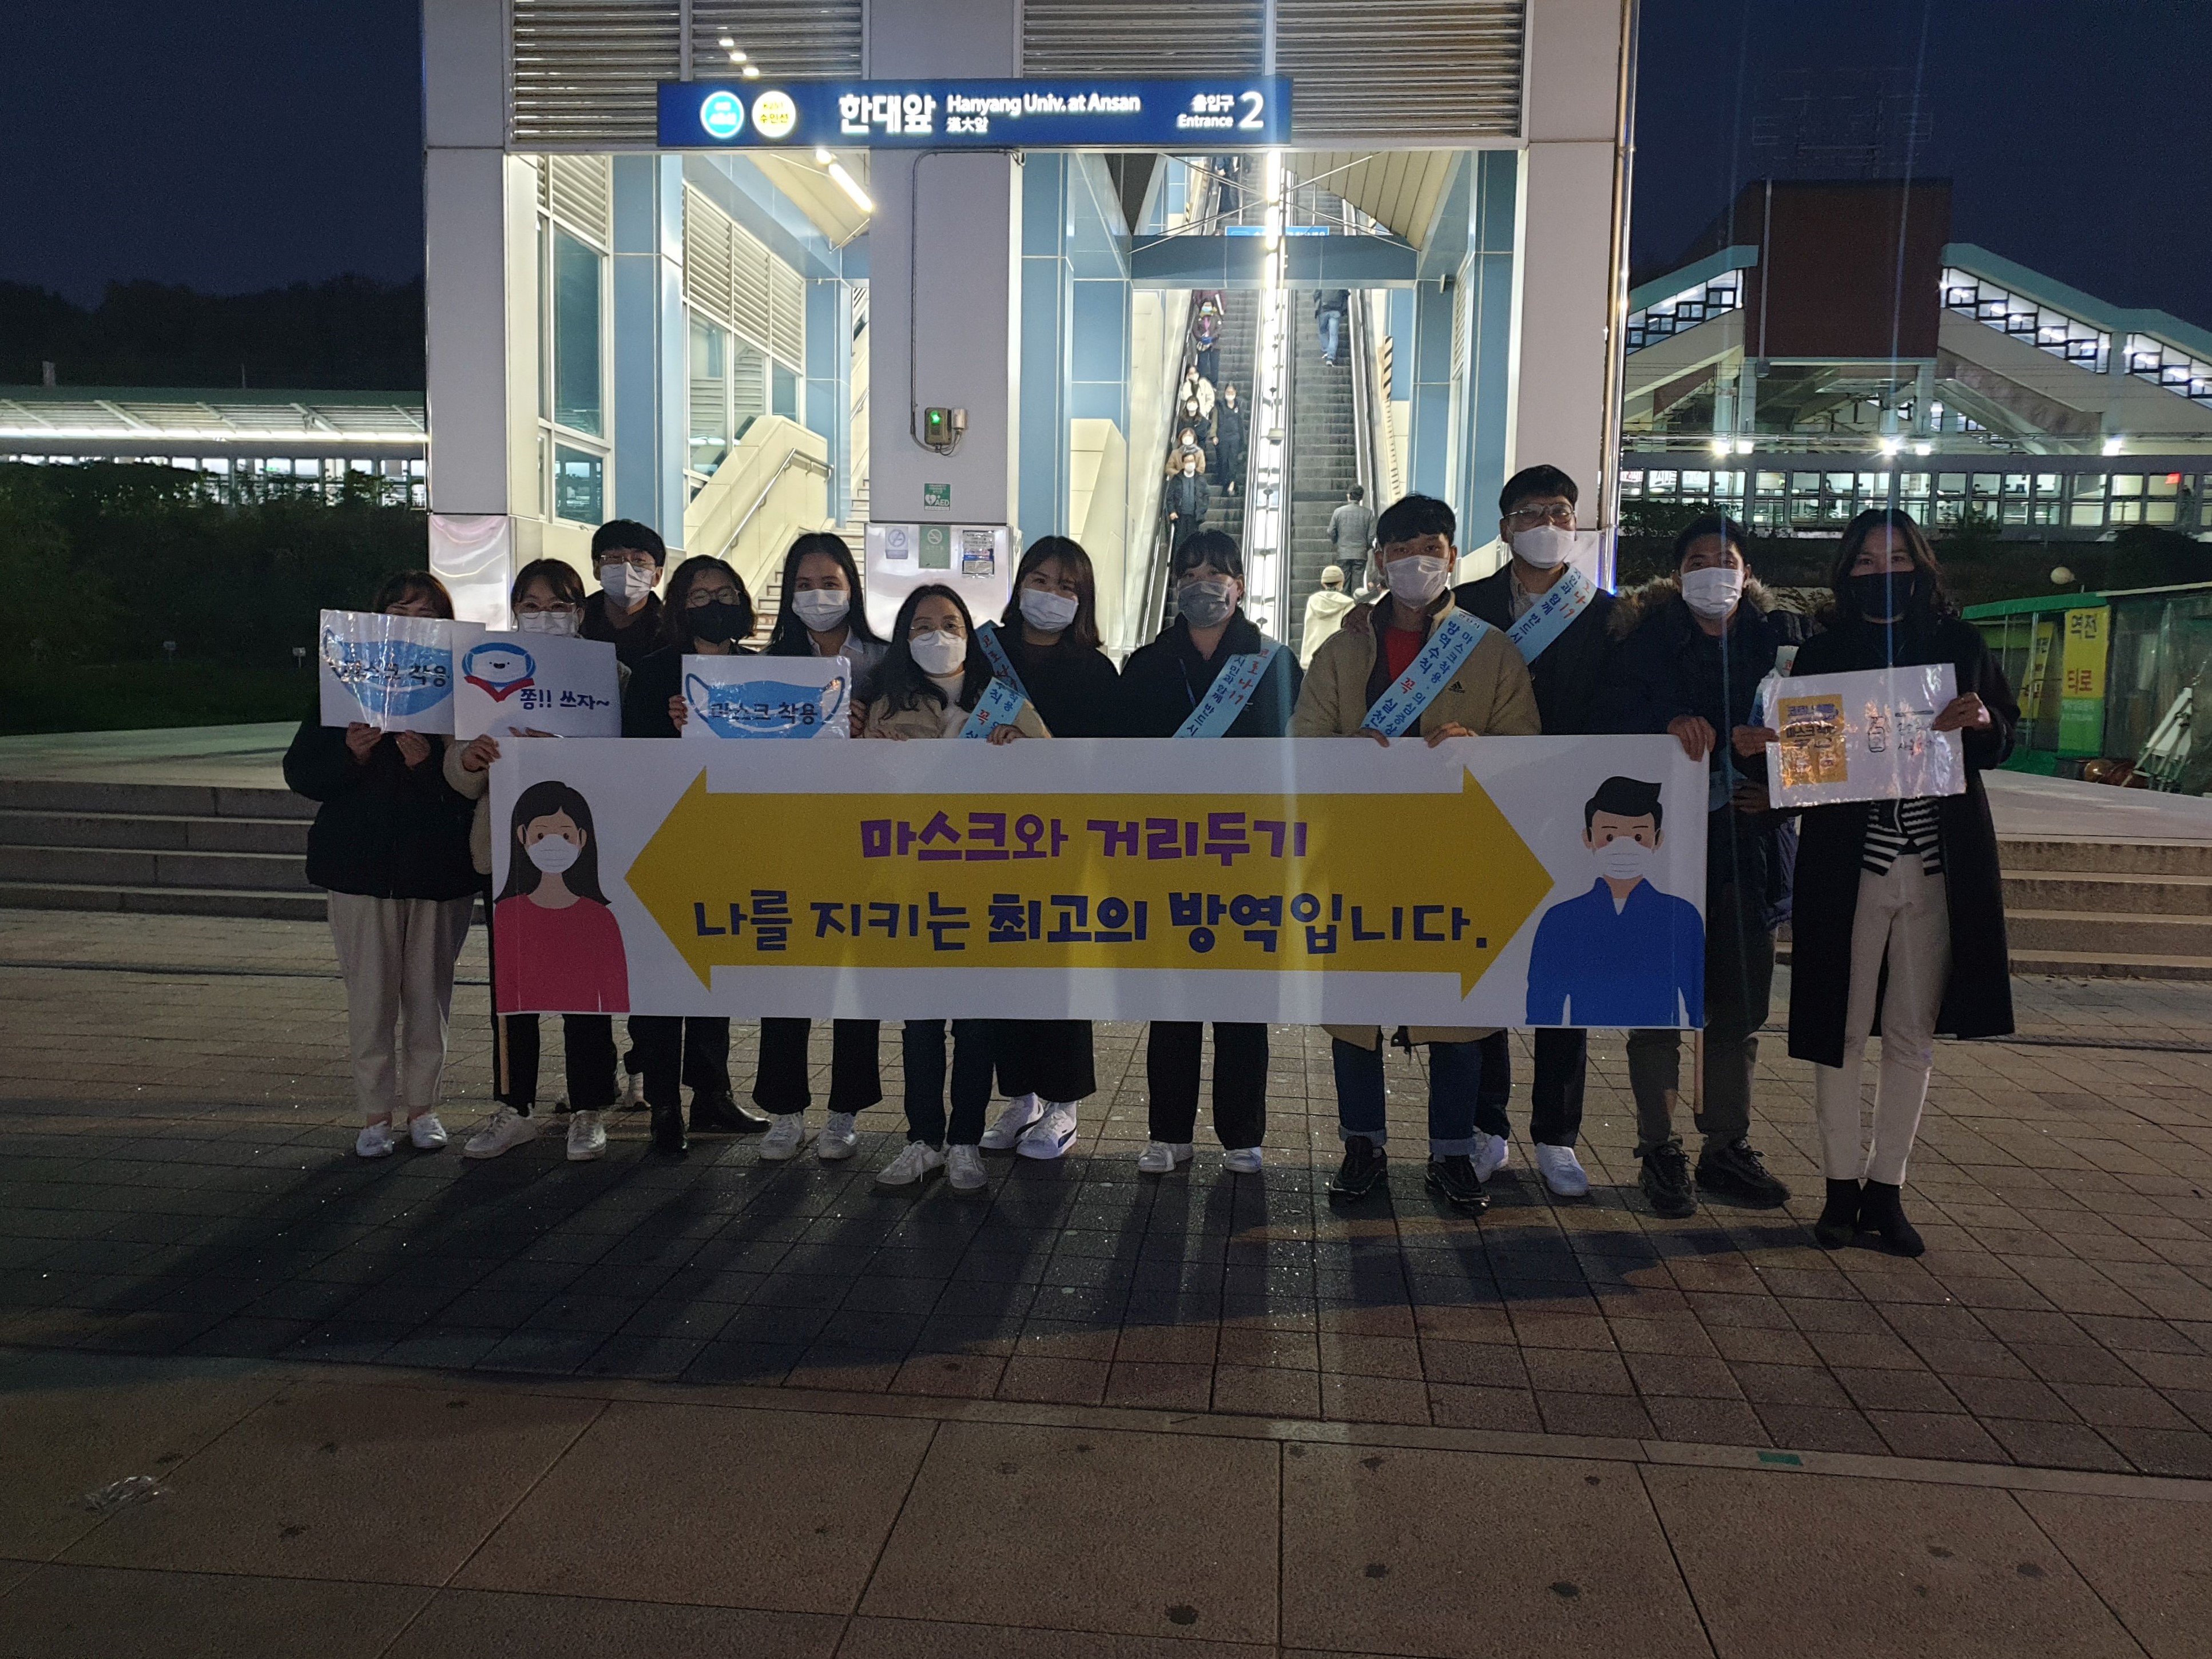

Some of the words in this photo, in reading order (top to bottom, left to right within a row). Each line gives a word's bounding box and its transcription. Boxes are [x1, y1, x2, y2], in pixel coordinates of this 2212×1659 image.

[839, 93, 936, 134] 한대앞
[947, 94, 1022, 117] Hanyang
[1024, 94, 1066, 112] Univ.
[1068, 95, 1086, 112] at
[1087, 94, 1141, 112] Ansan
[1190, 93, 1235, 113] 출입구
[1237, 90, 1264, 130] 2
[760, 113, 789, 124] 수인선
[1177, 114, 1234, 128] Entrance
[1541, 593, 1562, 615] 함께
[1510, 613, 1541, 644] 반드시
[1419, 620, 1462, 675] 방역수칙
[1223, 656, 1246, 685] 시민과
[1212, 685, 1228, 703] 함께
[1400, 677, 1416, 694] 꼭
[710, 702, 772, 721] 마스크
[778, 701, 818, 725] 착용
[976, 709, 990, 725] 꼭
[1186, 703, 1215, 737] 반드시
[860, 810, 1069, 861] 마스크와
[1087, 811, 1308, 867] 거리두기
[694, 889, 793, 951] 나를
[810, 892, 971, 951] 지키는
[988, 893, 1147, 945] 최고의
[1169, 892, 1487, 954] 방역입니다.
